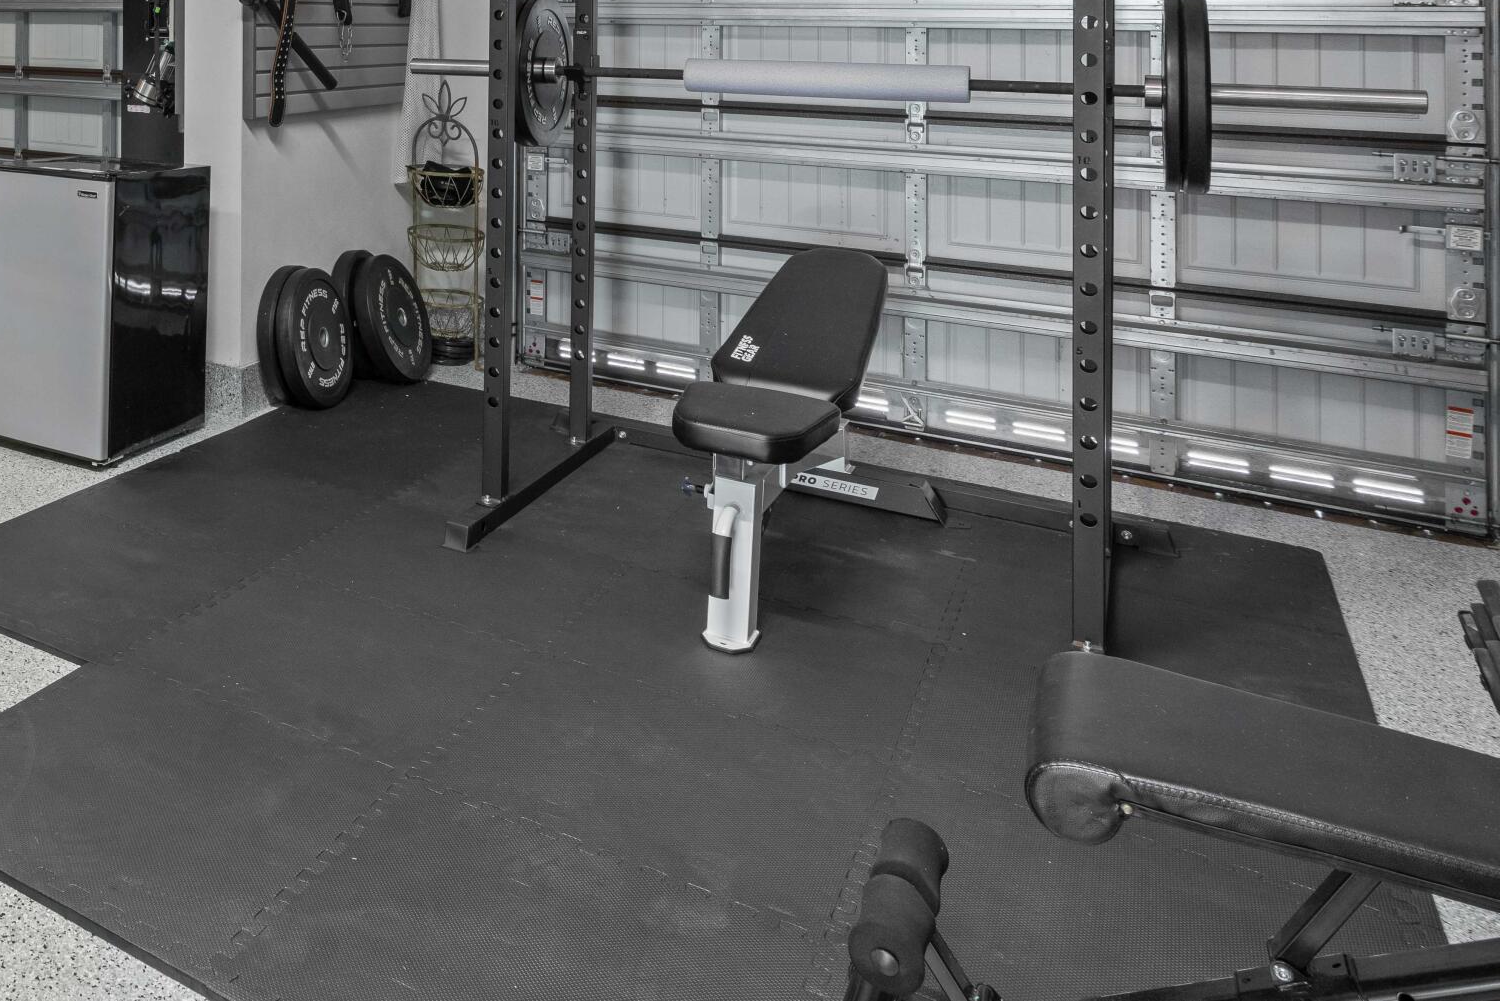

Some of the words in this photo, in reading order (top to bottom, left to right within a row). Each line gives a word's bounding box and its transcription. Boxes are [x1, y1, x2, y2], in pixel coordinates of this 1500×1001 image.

[547, 16, 560, 34] REP
[1077, 156, 1091, 165] 10
[301, 288, 328, 317] FITNESS
[378, 279, 389, 333] FITNESS
[412, 302, 424, 354] FITNESS
[730, 334, 754, 360] FITNESS
[741, 344, 760, 363] GEAR
[1076, 346, 1084, 355] 5
[319, 357, 345, 388] FITNESS
[822, 479, 868, 497] SERIES
